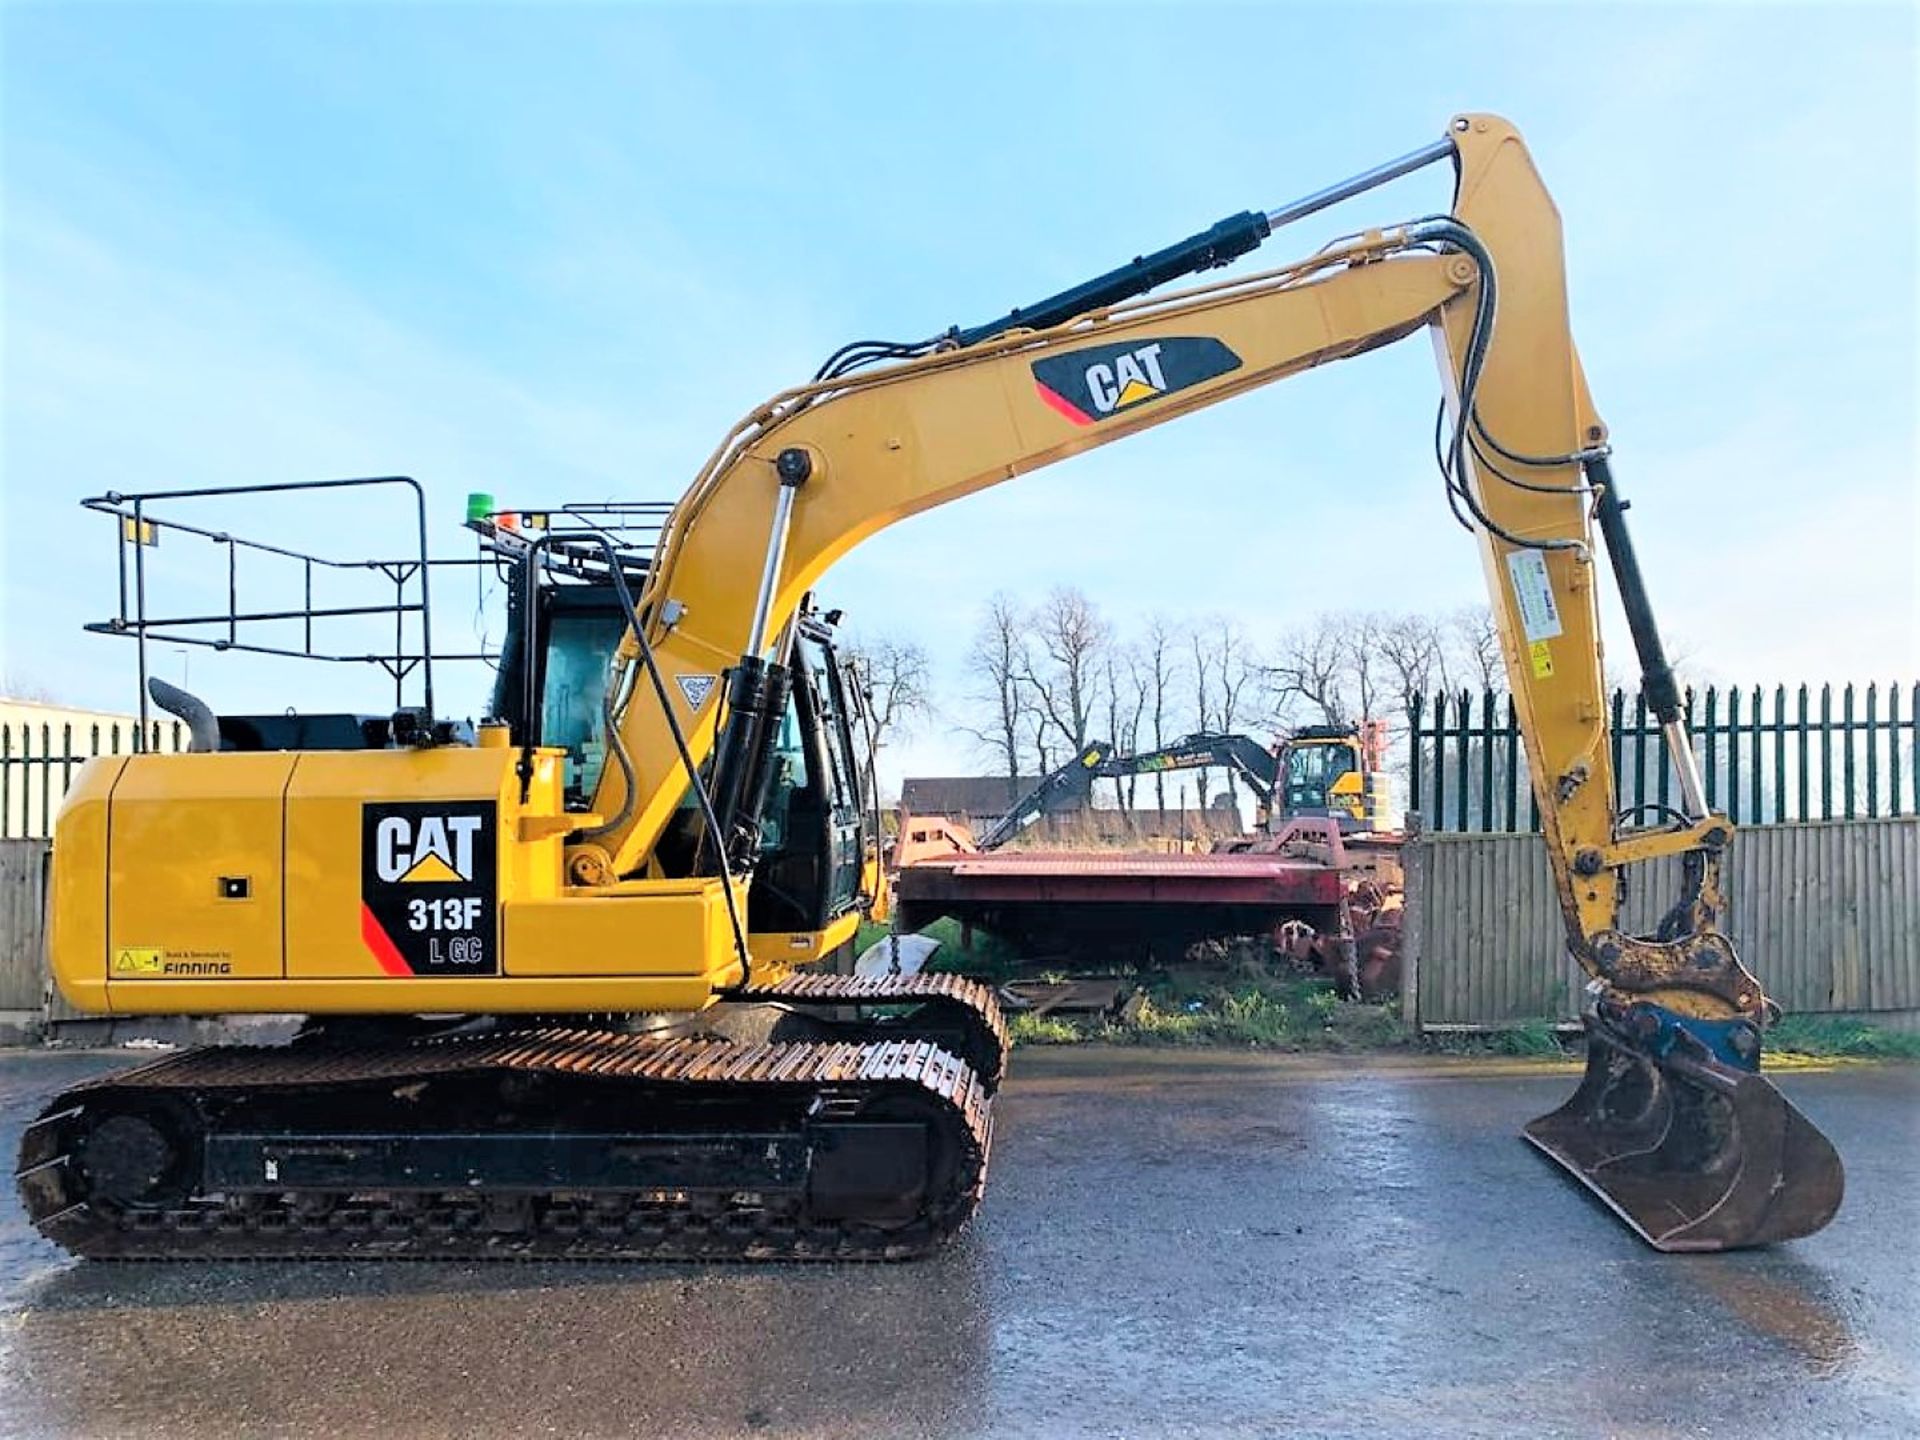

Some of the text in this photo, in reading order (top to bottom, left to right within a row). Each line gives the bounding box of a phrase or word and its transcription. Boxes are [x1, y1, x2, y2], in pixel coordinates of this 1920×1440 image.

[1085, 343, 1167, 412] CAT
[377, 816, 482, 883] CAT
[408, 897, 482, 931] 313F
[430, 936, 483, 964] L GC
